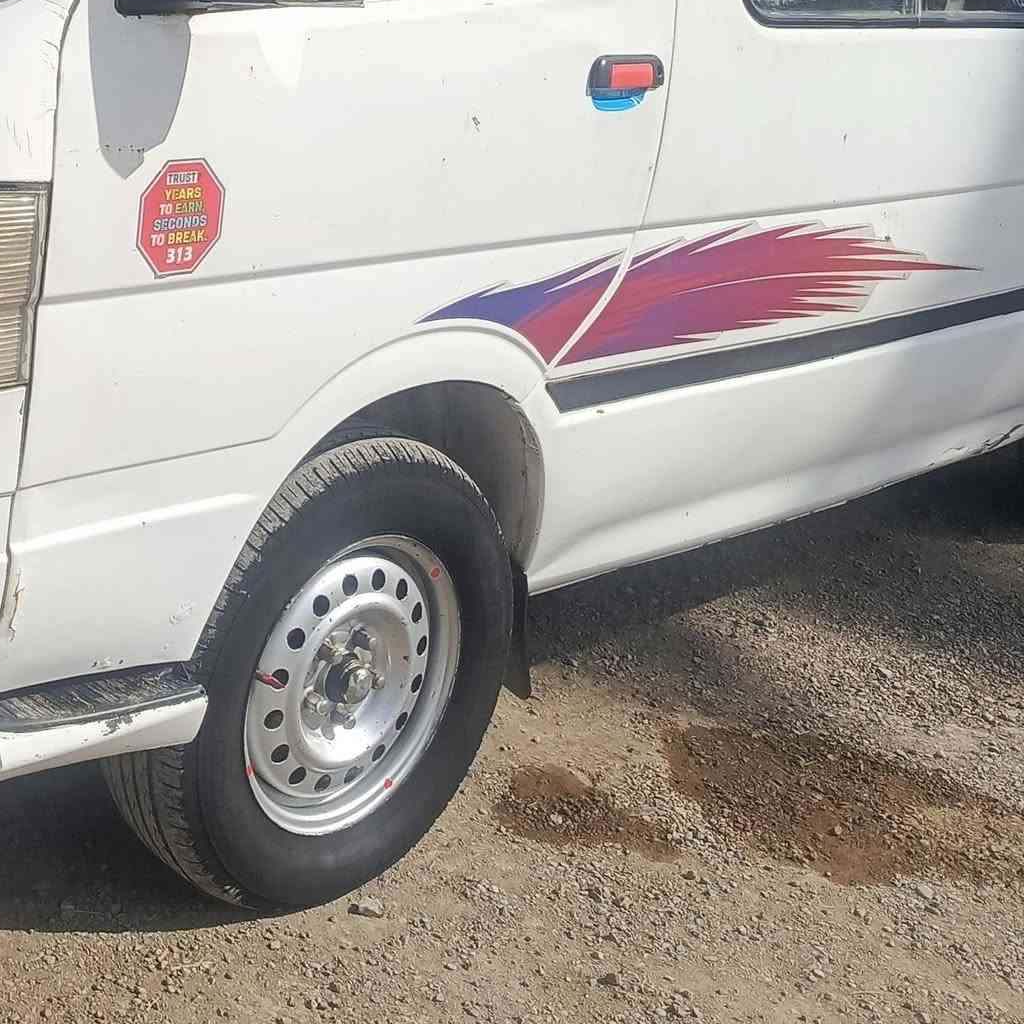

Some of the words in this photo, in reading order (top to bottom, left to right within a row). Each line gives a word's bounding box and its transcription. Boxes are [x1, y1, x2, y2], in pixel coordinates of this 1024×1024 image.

[167, 172, 198, 184] TRUST
[164, 187, 202, 201] YEARS
[159, 203, 172, 215] TO
[153, 215, 207, 231] SECONDS
[150, 234, 165, 247] TO
[167, 230, 208, 245] BREAK.
[166, 246, 193, 264] 313
